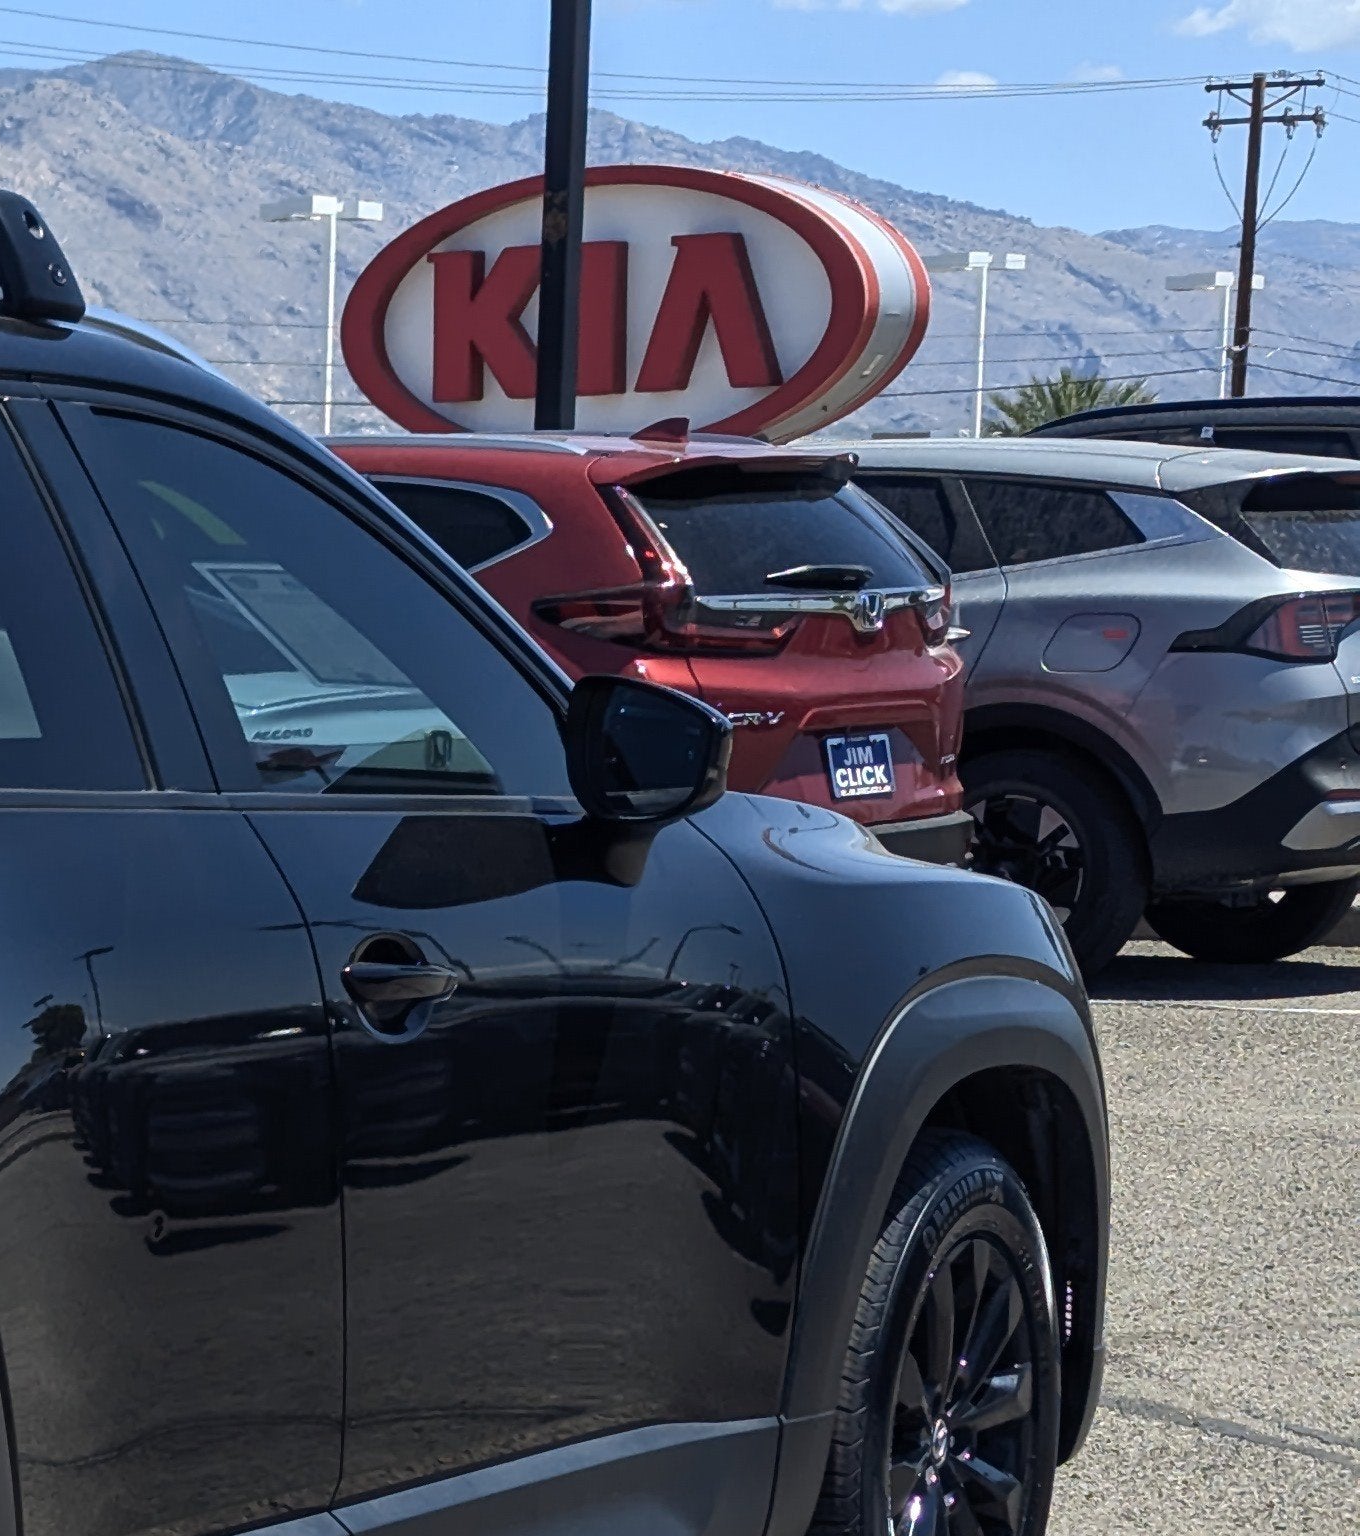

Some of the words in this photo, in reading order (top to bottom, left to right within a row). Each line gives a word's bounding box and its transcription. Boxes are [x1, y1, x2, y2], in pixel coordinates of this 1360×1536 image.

[427, 232, 784, 402] KIA
[843, 745, 874, 766] JIM
[836, 764, 889, 787] CLICK
